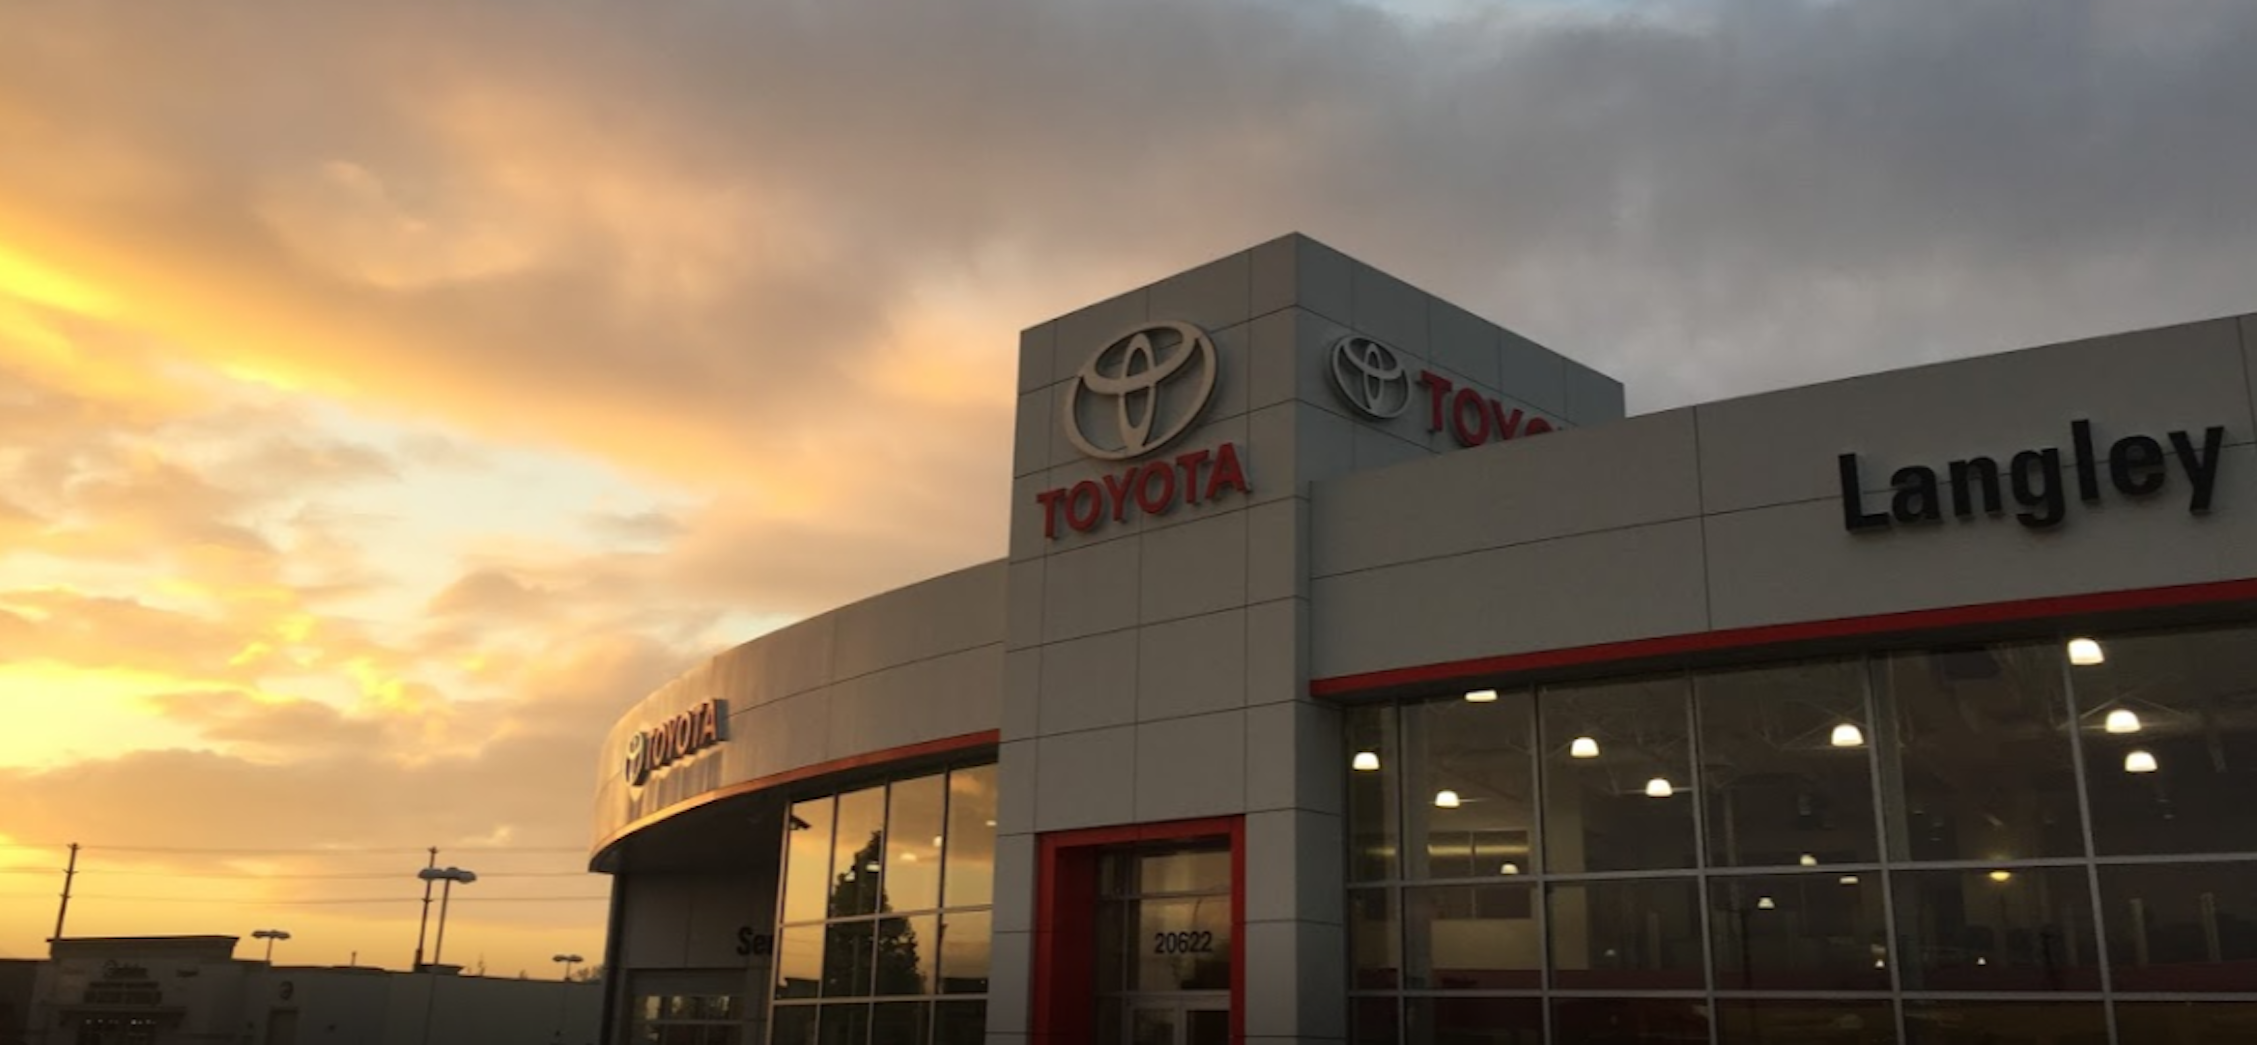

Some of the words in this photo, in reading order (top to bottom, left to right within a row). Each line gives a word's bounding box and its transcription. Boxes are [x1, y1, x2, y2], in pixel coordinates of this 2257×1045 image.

[1037, 441, 1248, 539] TOYOTA
[1838, 418, 2225, 532] Langley
[643, 697, 727, 771] TOYOTA
[1154, 931, 1213, 954] 20622
